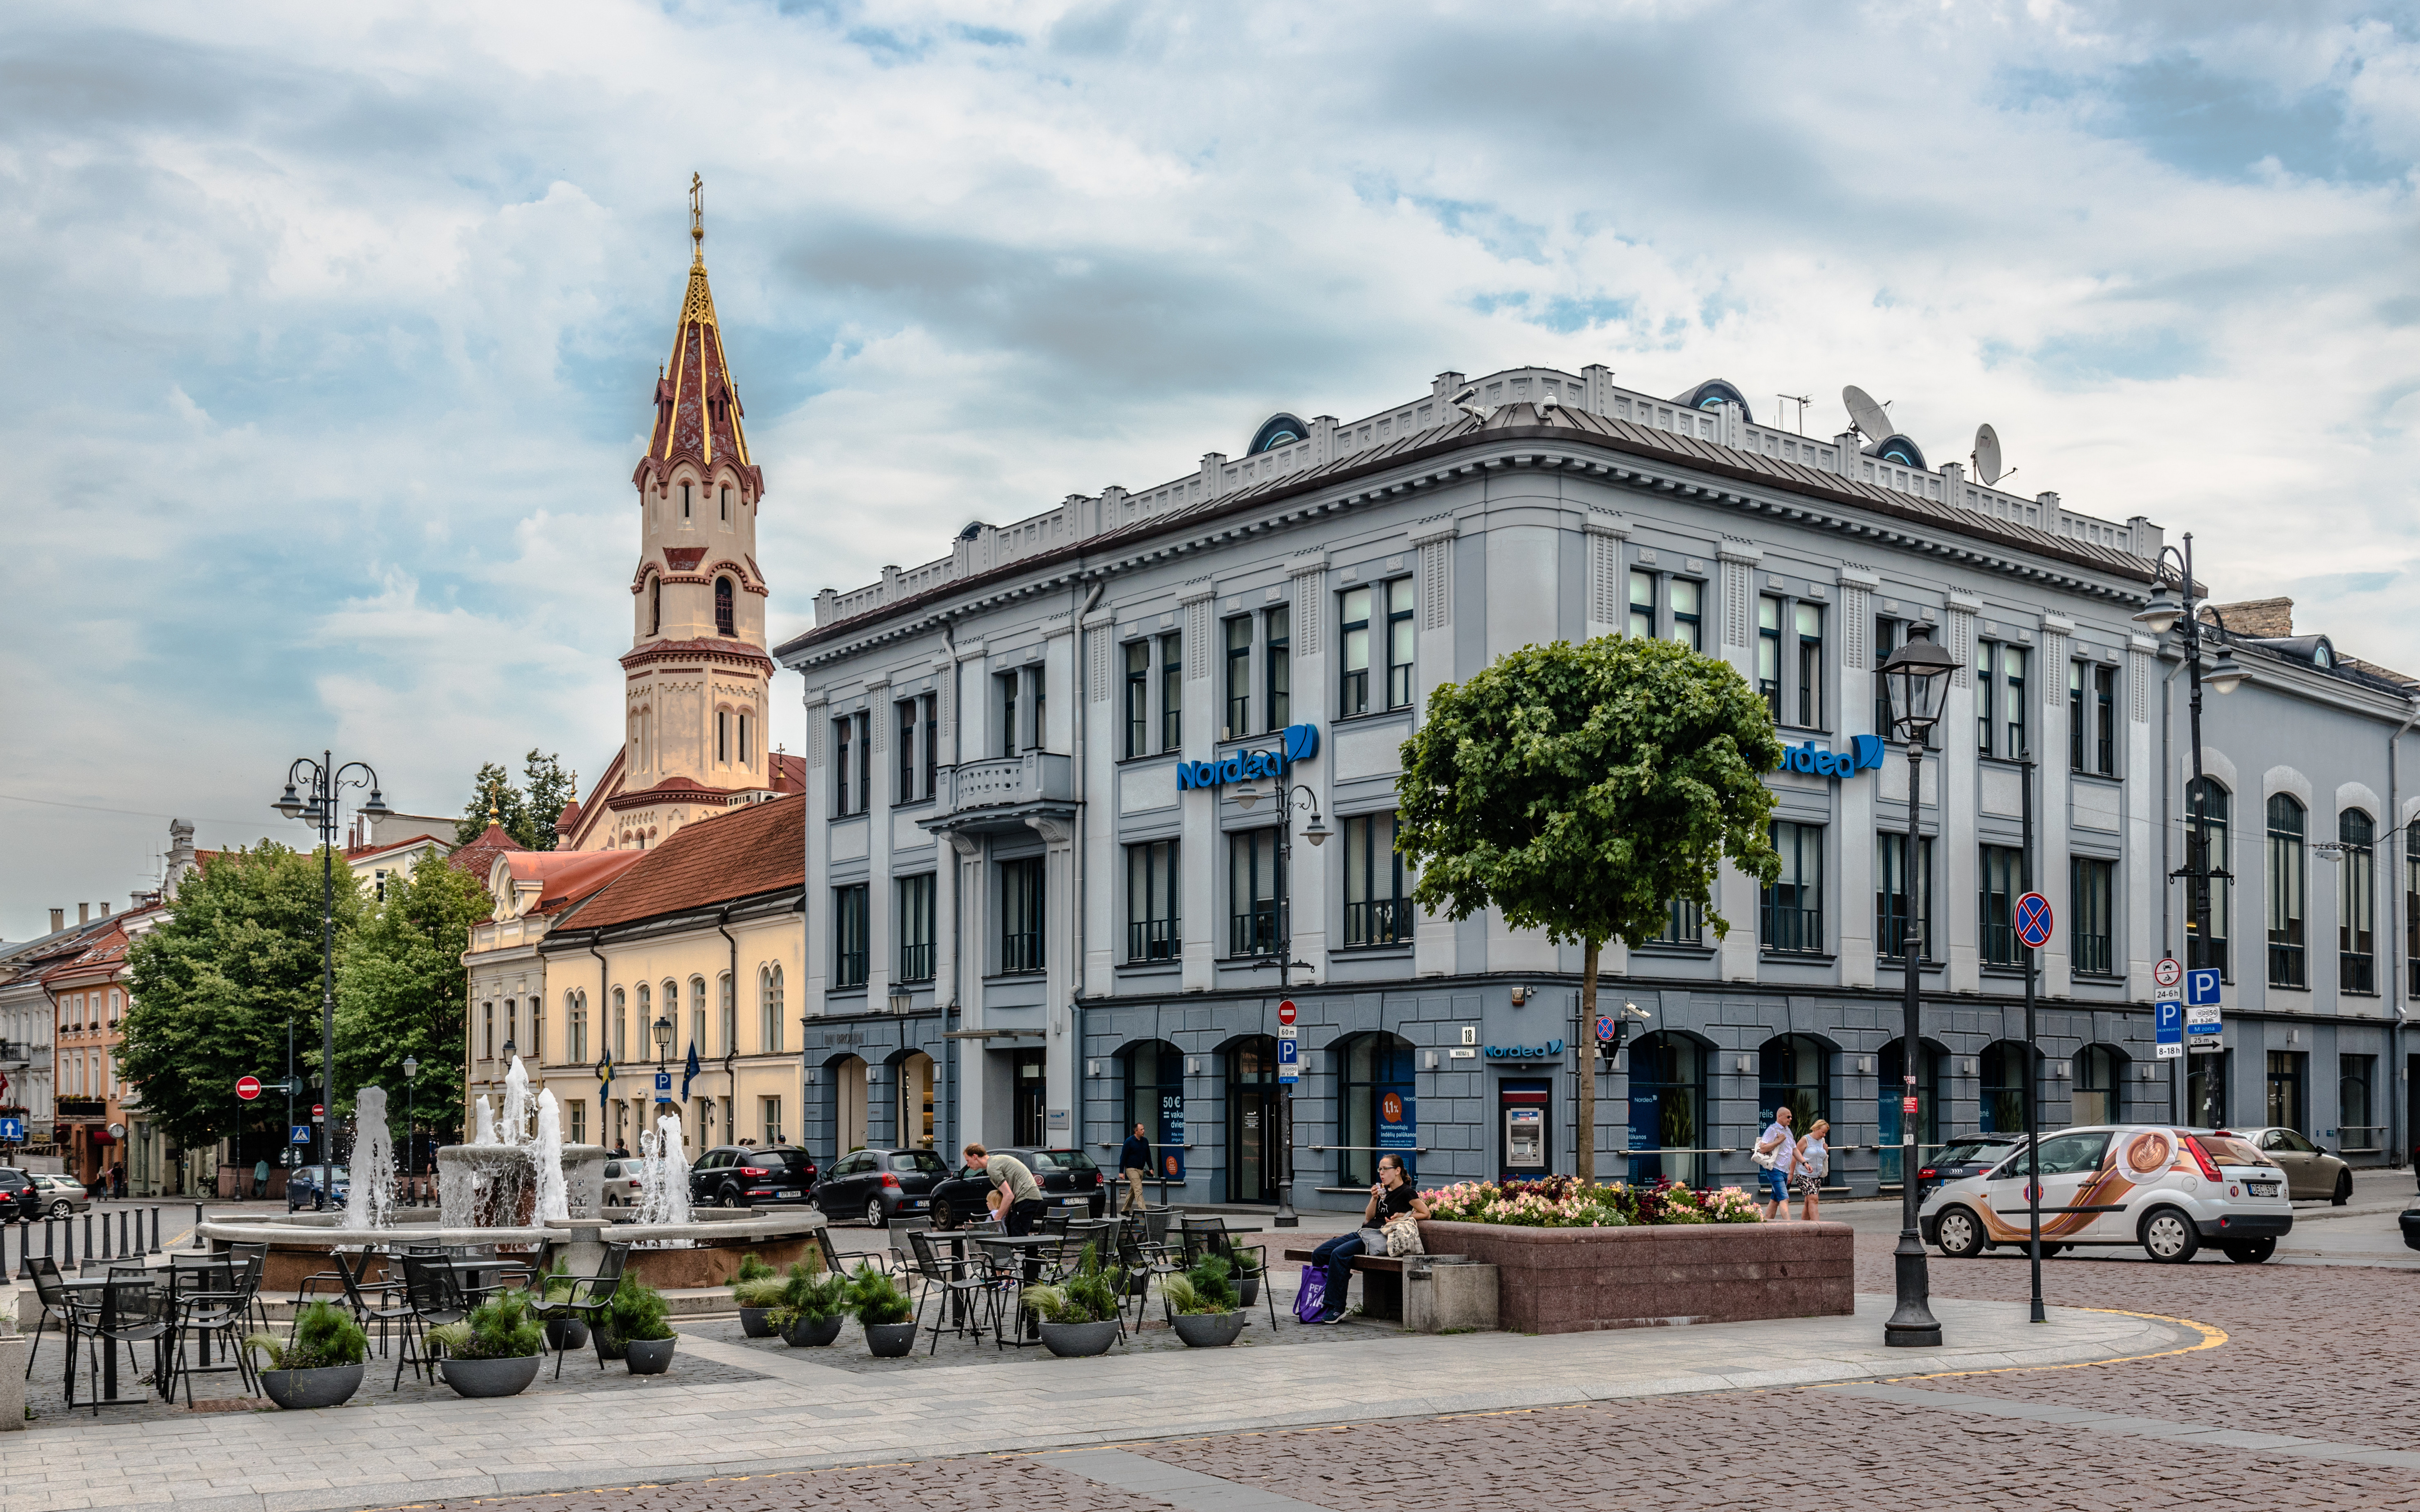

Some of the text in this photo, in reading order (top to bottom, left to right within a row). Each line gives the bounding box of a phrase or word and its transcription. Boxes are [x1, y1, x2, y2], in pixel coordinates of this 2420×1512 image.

[1177, 749, 1285, 790] Nordea
[2195, 973, 2214, 1001] P
[2157, 990, 2173, 998] 24-6
[2162, 1005, 2176, 1026] P
[1465, 1030, 1472, 1042] 18
[1284, 1042, 1294, 1061] P
[1484, 1044, 1546, 1057] Nordea
[659, 1074, 668, 1088] P
[1163, 1096, 1181, 1108] 50 €
[1171, 1110, 1184, 1118] vaka
[1759, 1109, 1773, 1118] rėlis
[2251, 1185, 2264, 1193] DEC
